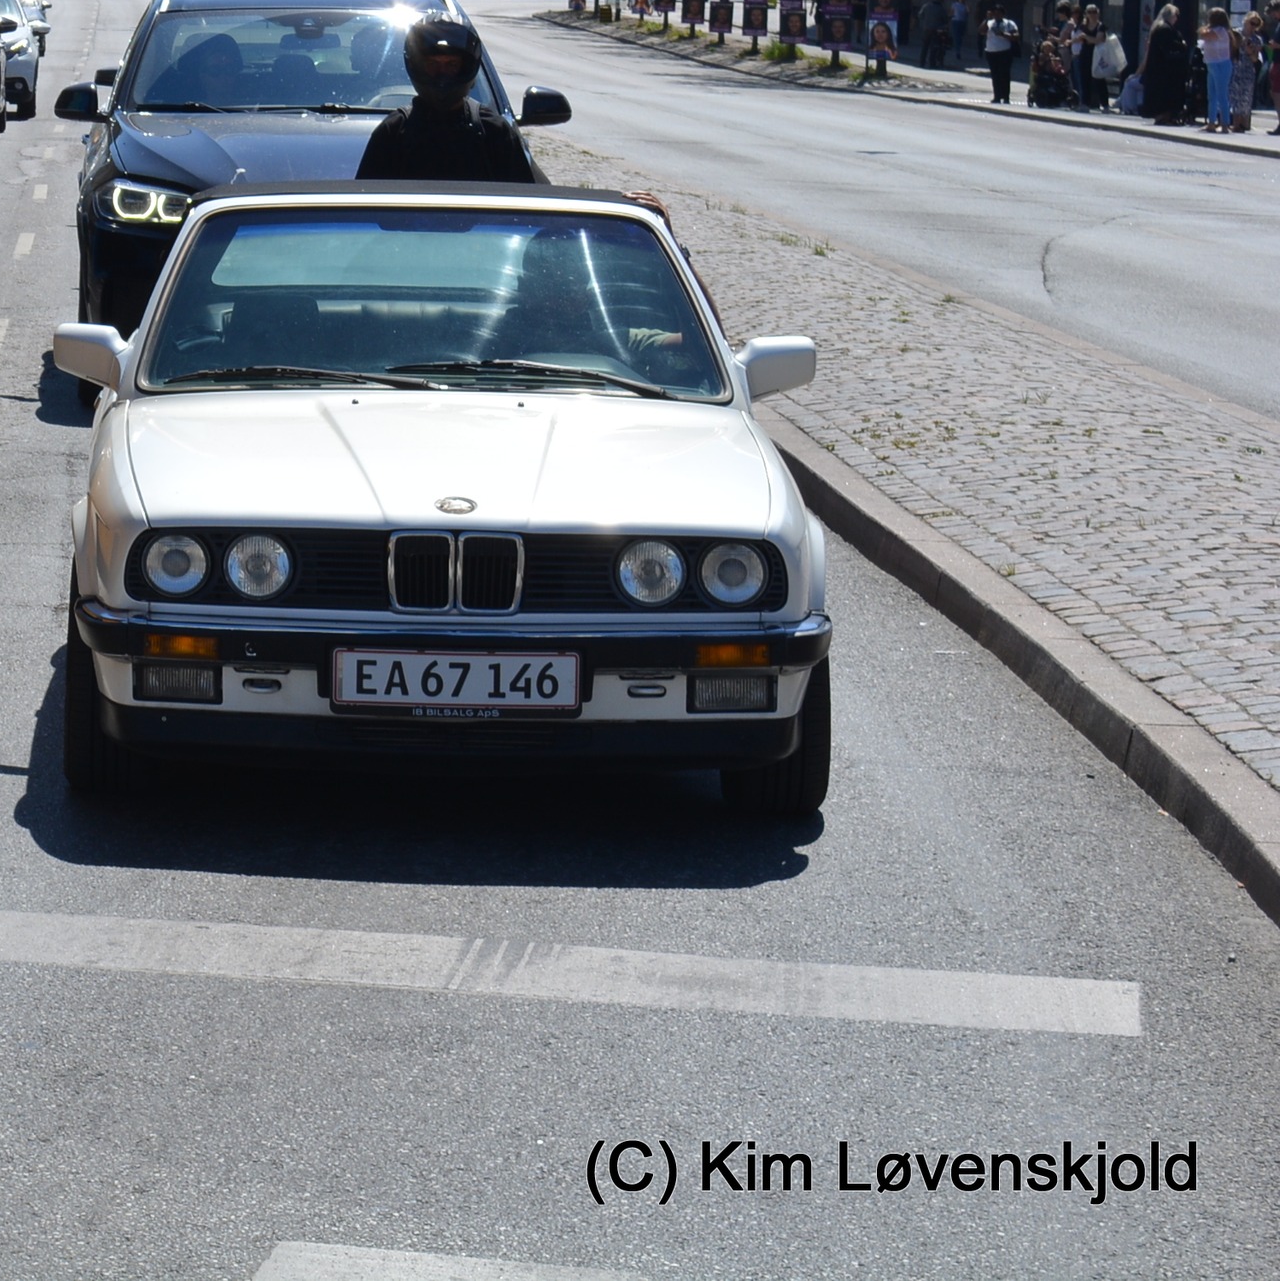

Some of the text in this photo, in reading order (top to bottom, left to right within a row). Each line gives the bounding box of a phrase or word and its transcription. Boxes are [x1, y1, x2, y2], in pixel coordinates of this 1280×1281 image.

[356, 659, 559, 699] EA 67 146
[426, 708, 474, 717] BILSALG
